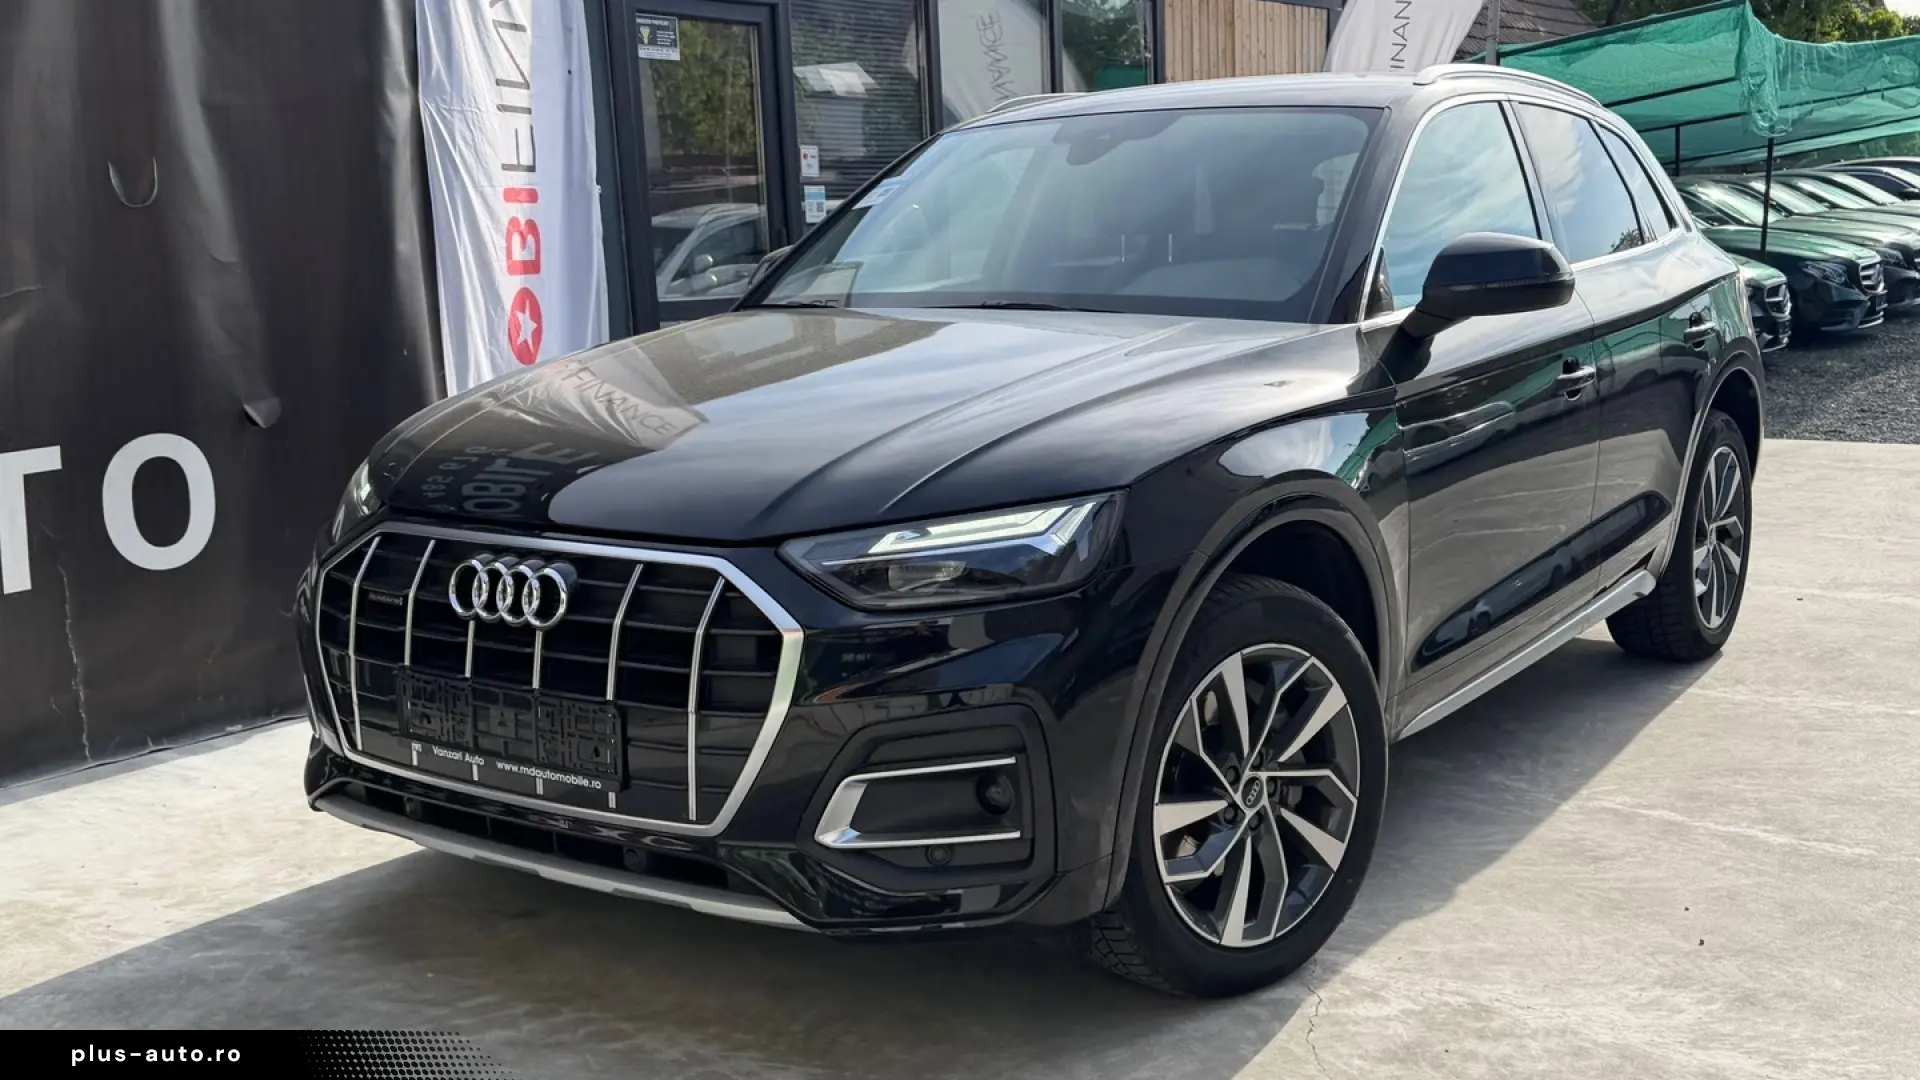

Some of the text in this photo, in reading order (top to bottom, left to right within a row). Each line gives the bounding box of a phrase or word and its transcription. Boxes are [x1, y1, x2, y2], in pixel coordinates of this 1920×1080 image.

[0, 432, 217, 595] TO
[464, 752, 485, 766] Auto
[496, 760, 602, 789] www.mdautomobile.ro
